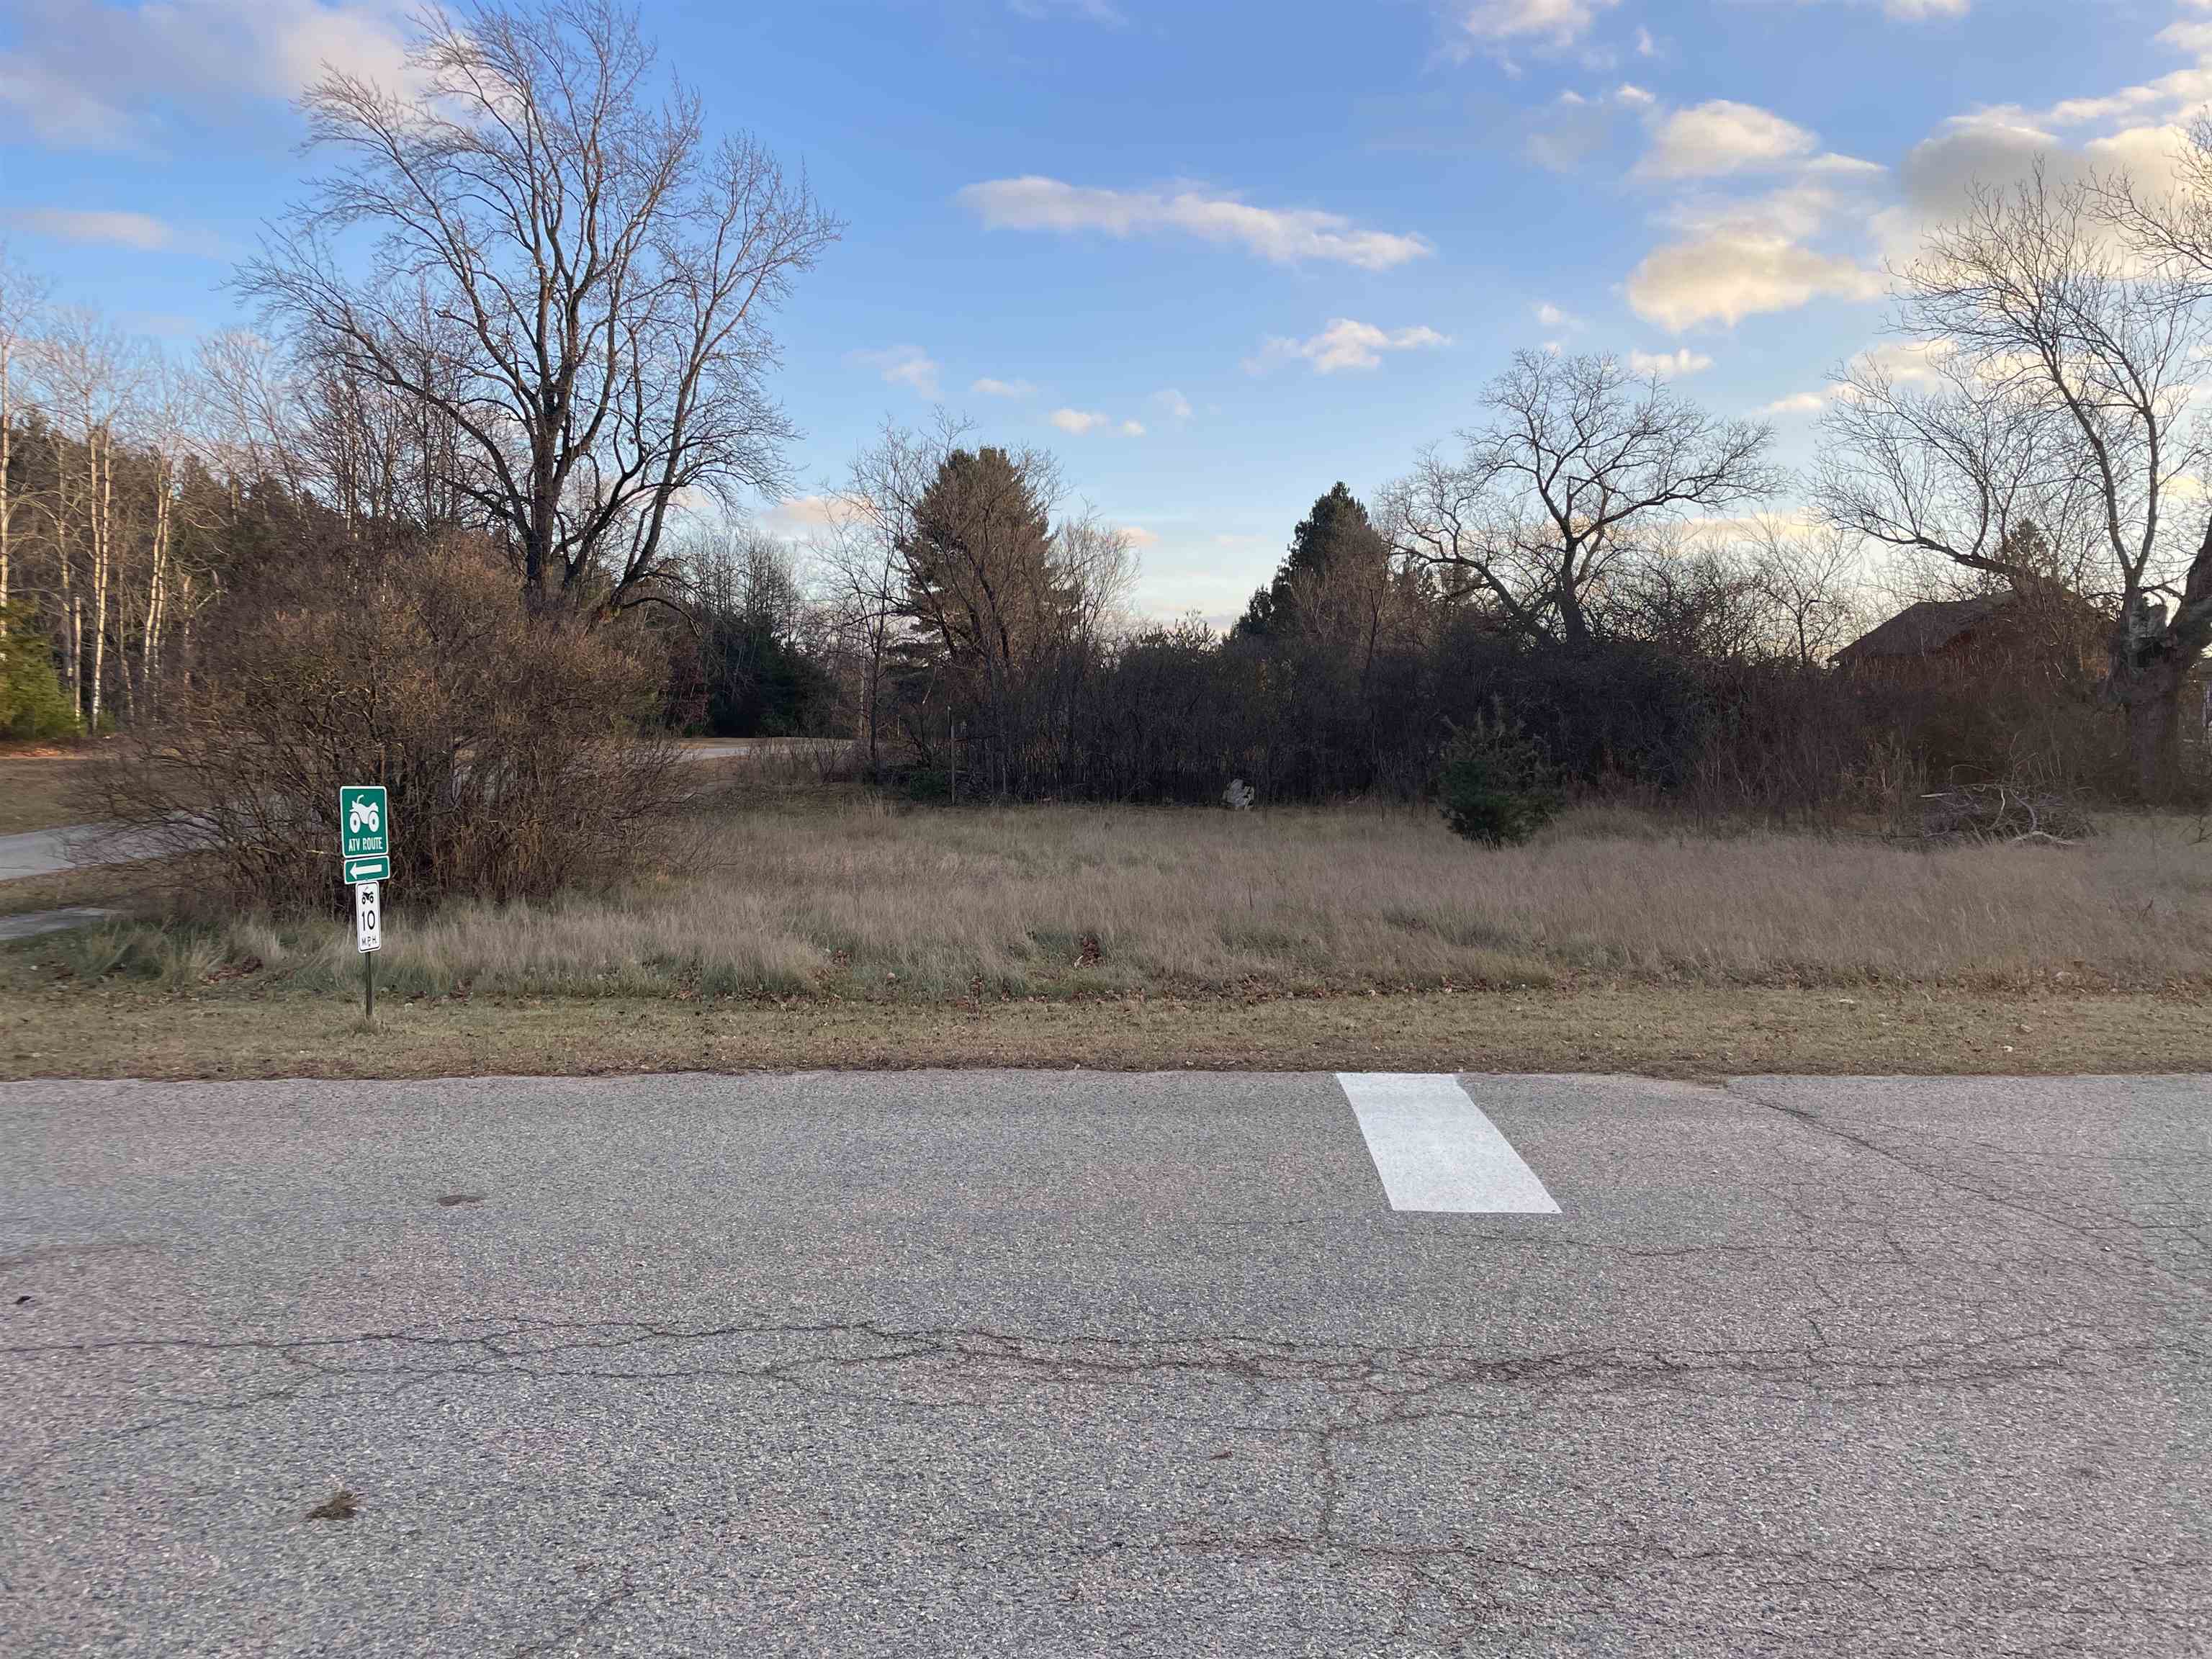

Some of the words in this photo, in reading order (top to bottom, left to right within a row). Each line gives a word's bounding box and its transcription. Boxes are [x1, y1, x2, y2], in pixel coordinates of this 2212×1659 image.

[349, 838, 360, 851] ATV
[362, 837, 383, 850] ROUTE
[361, 910, 375, 931] 10
